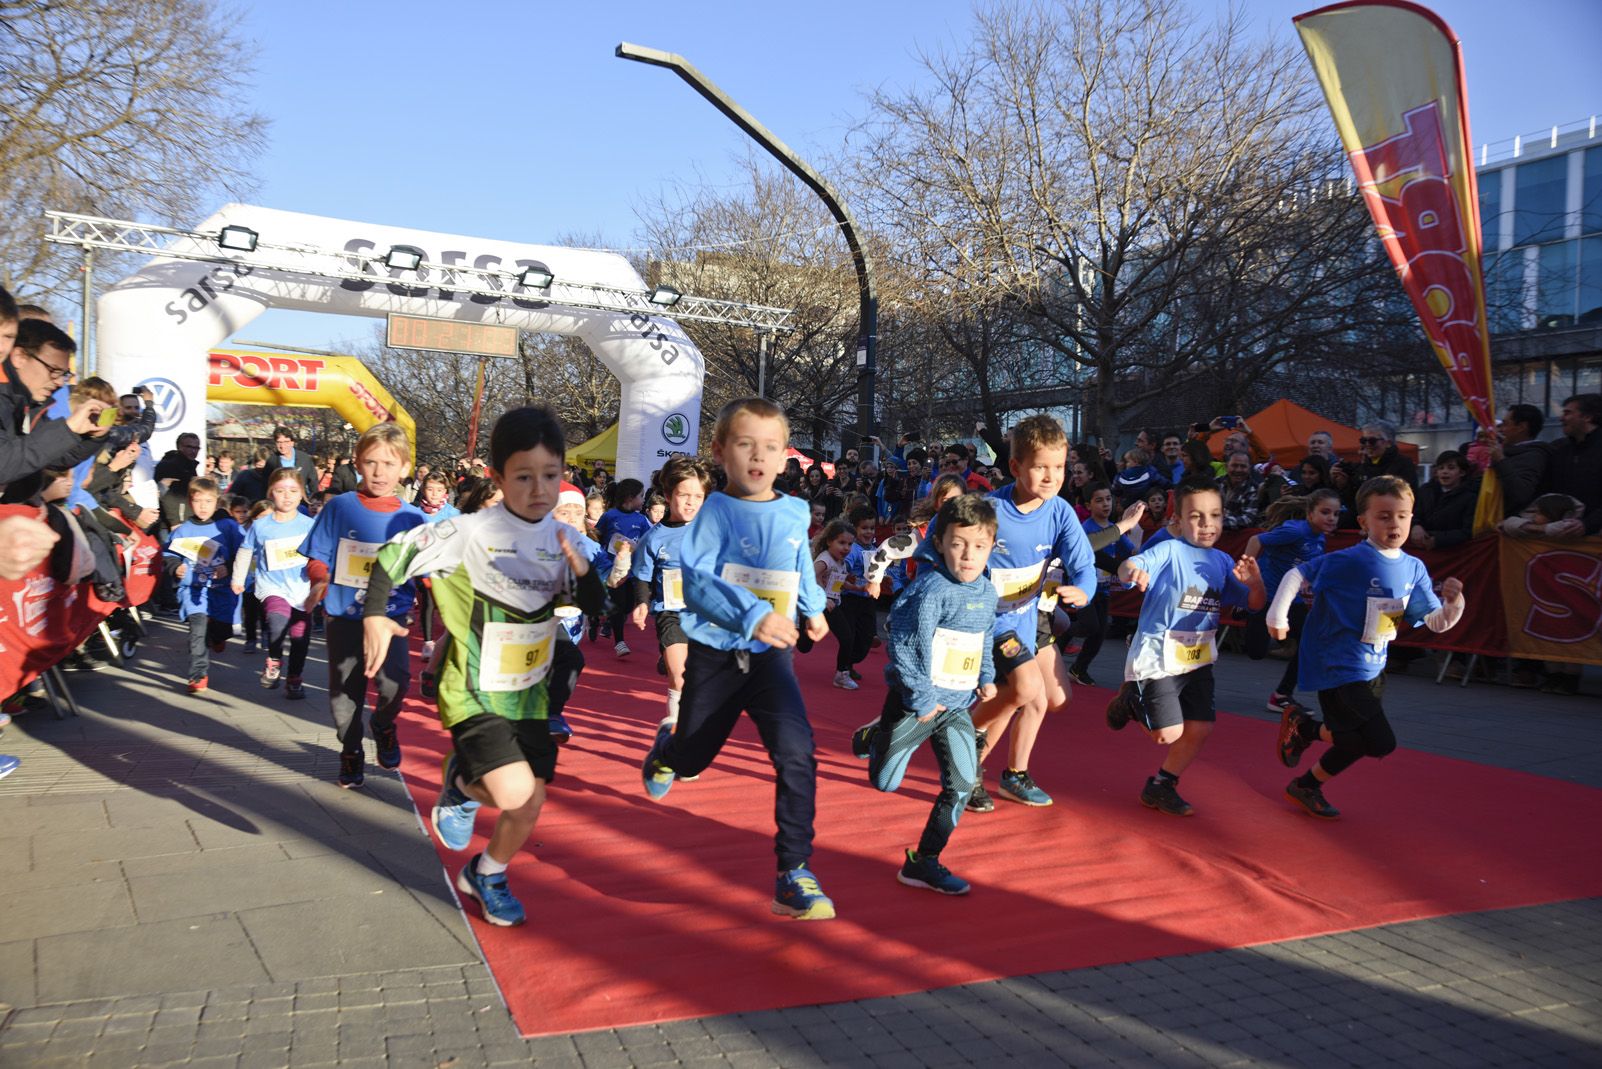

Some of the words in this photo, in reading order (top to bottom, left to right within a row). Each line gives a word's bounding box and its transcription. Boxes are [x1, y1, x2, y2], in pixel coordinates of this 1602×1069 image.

[340, 238, 550, 309] sarsa
[525, 649, 540, 667] 97
[963, 657, 975, 671] 61
